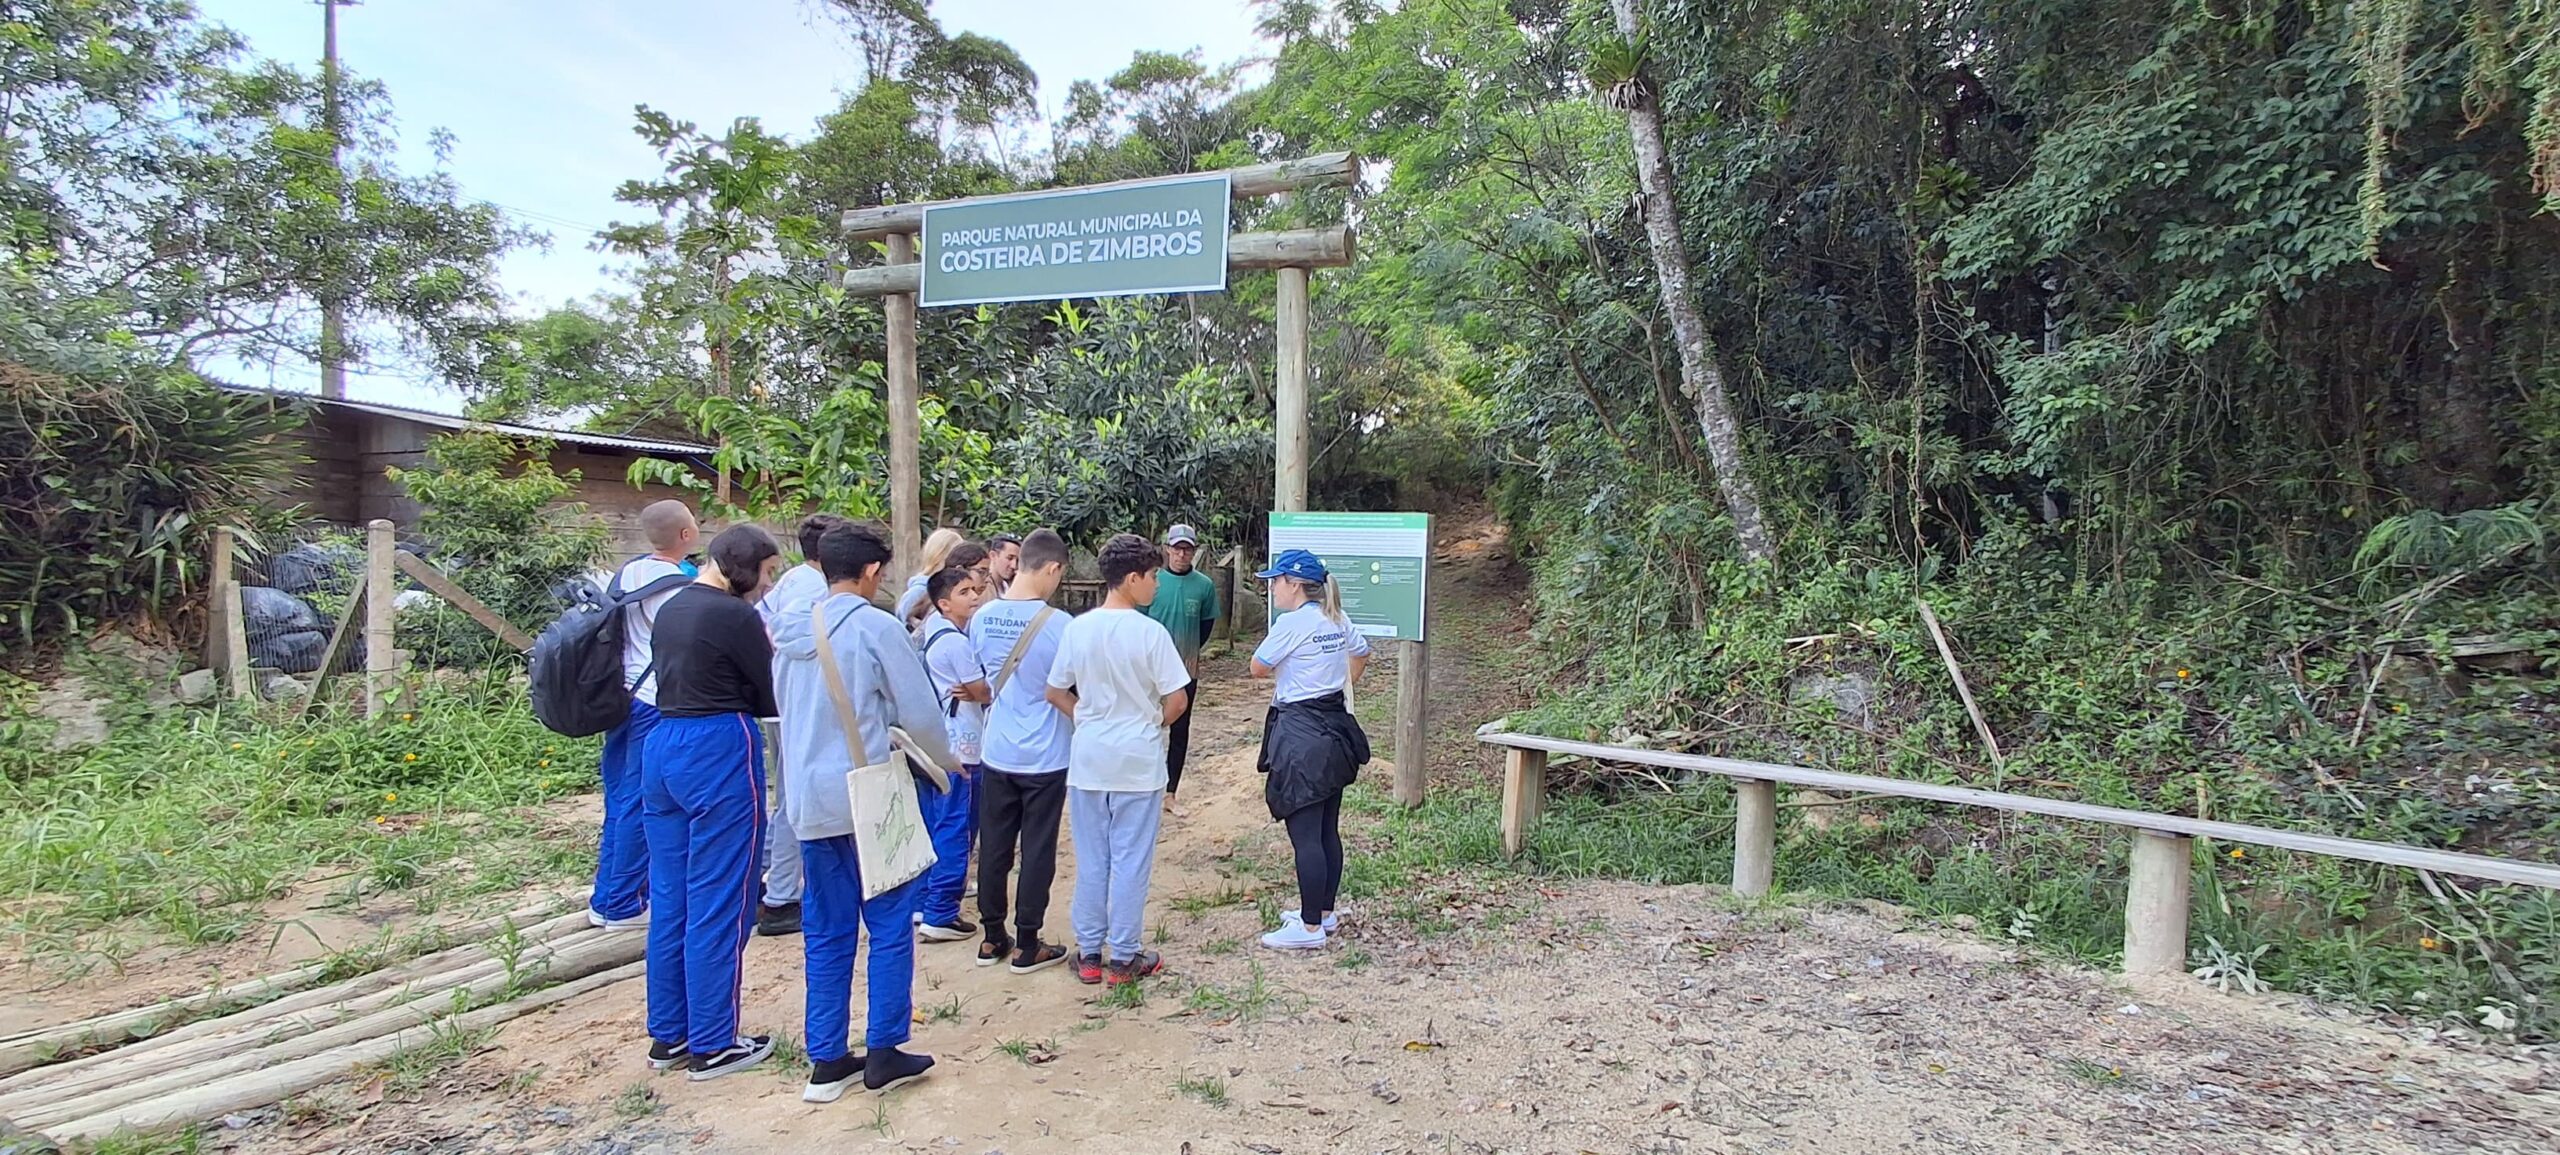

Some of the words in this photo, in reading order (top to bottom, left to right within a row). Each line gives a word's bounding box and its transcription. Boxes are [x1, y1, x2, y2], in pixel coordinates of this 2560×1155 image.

[941, 227, 1002, 247] PARQUE
[1004, 220, 1077, 241] NATURAL
[1079, 213, 1172, 235] MUNICIPAL
[1175, 208, 1202, 227] DA
[940, 244, 1046, 273] COSTEIRA
[1050, 240, 1083, 266] DE
[1087, 230, 1203, 263] ZIMBROS
[985, 627, 1009, 635] ESCOLA
